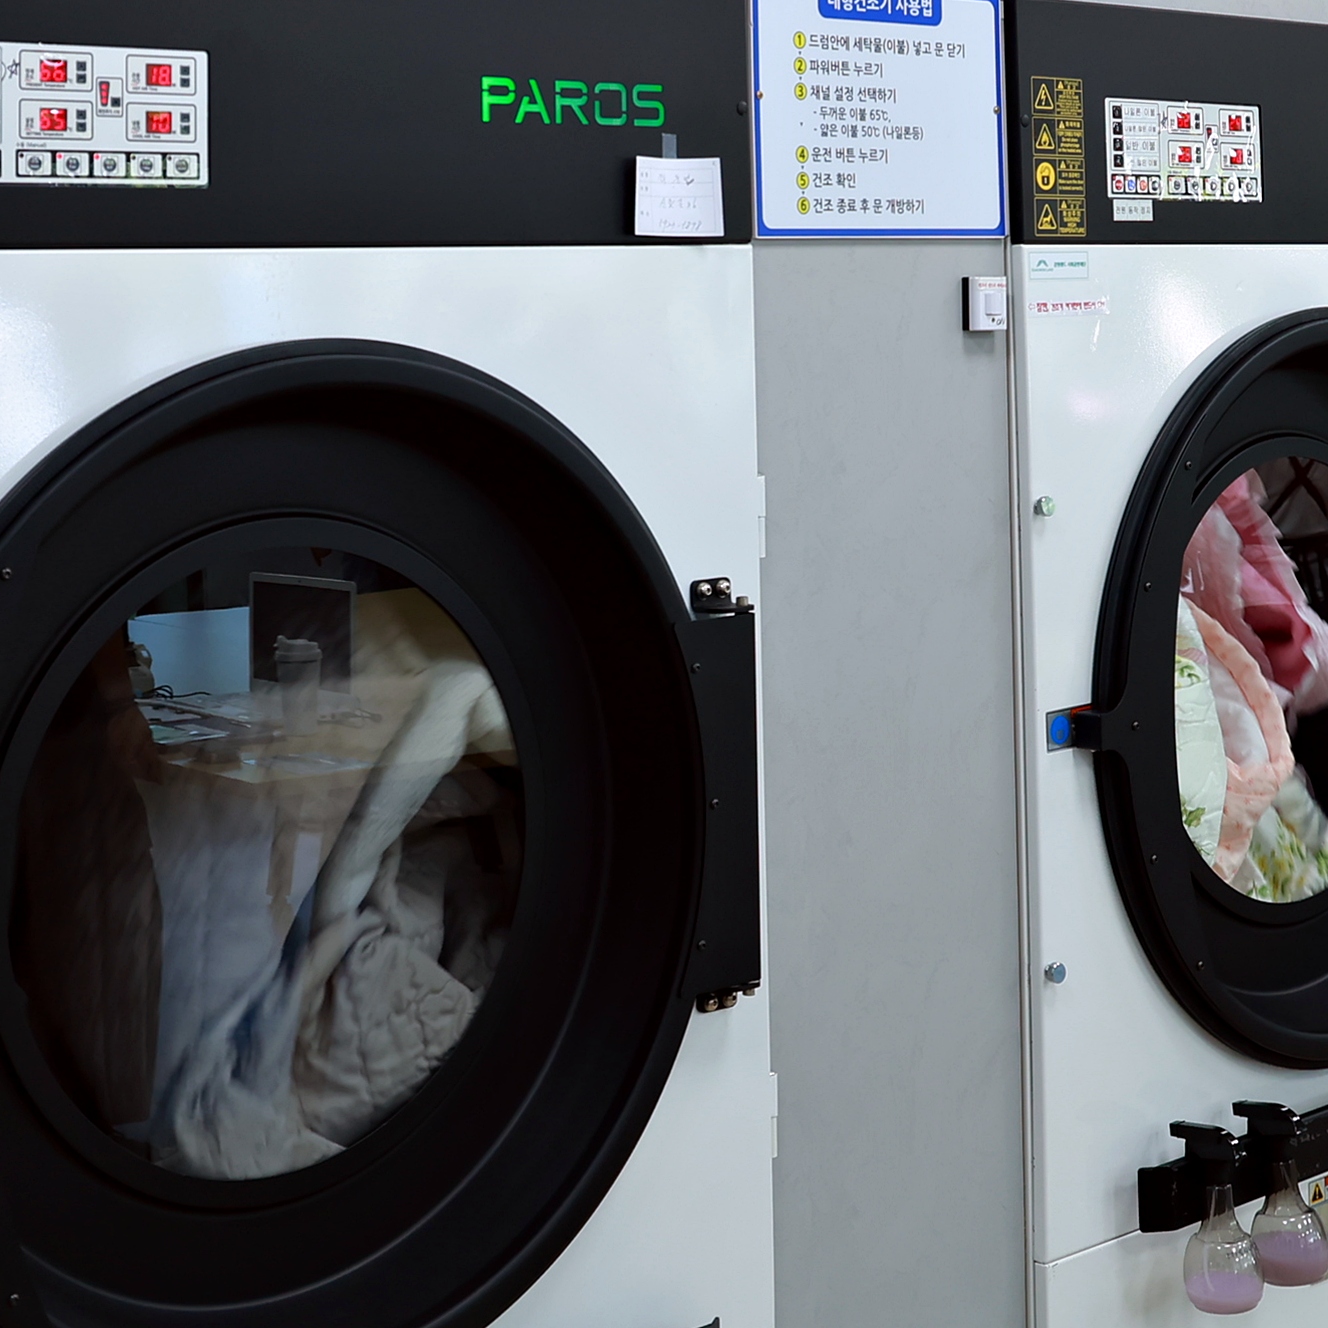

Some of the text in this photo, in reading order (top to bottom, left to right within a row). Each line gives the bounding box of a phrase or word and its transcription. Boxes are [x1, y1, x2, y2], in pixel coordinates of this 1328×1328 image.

[808, 34, 851, 51] 드럼안에
[912, 40, 932, 56] 넣고
[933, 41, 945, 58] 문
[946, 42, 966, 59] 닫기
[809, 59, 883, 79] 파워버튼 누르기
[481, 75, 666, 127] PAROS
[810, 85, 897, 104] 채널 설정 선택하기
[819, 105, 847, 121] 두꺼운
[849, 107, 867, 122] 이불
[840, 124, 859, 139] 이불
[810, 146, 889, 165] 운전 버튼 누르기
[812, 172, 856, 189] 건조 확인
[813, 198, 925, 215] 건조 종료 후 문 개방하기
